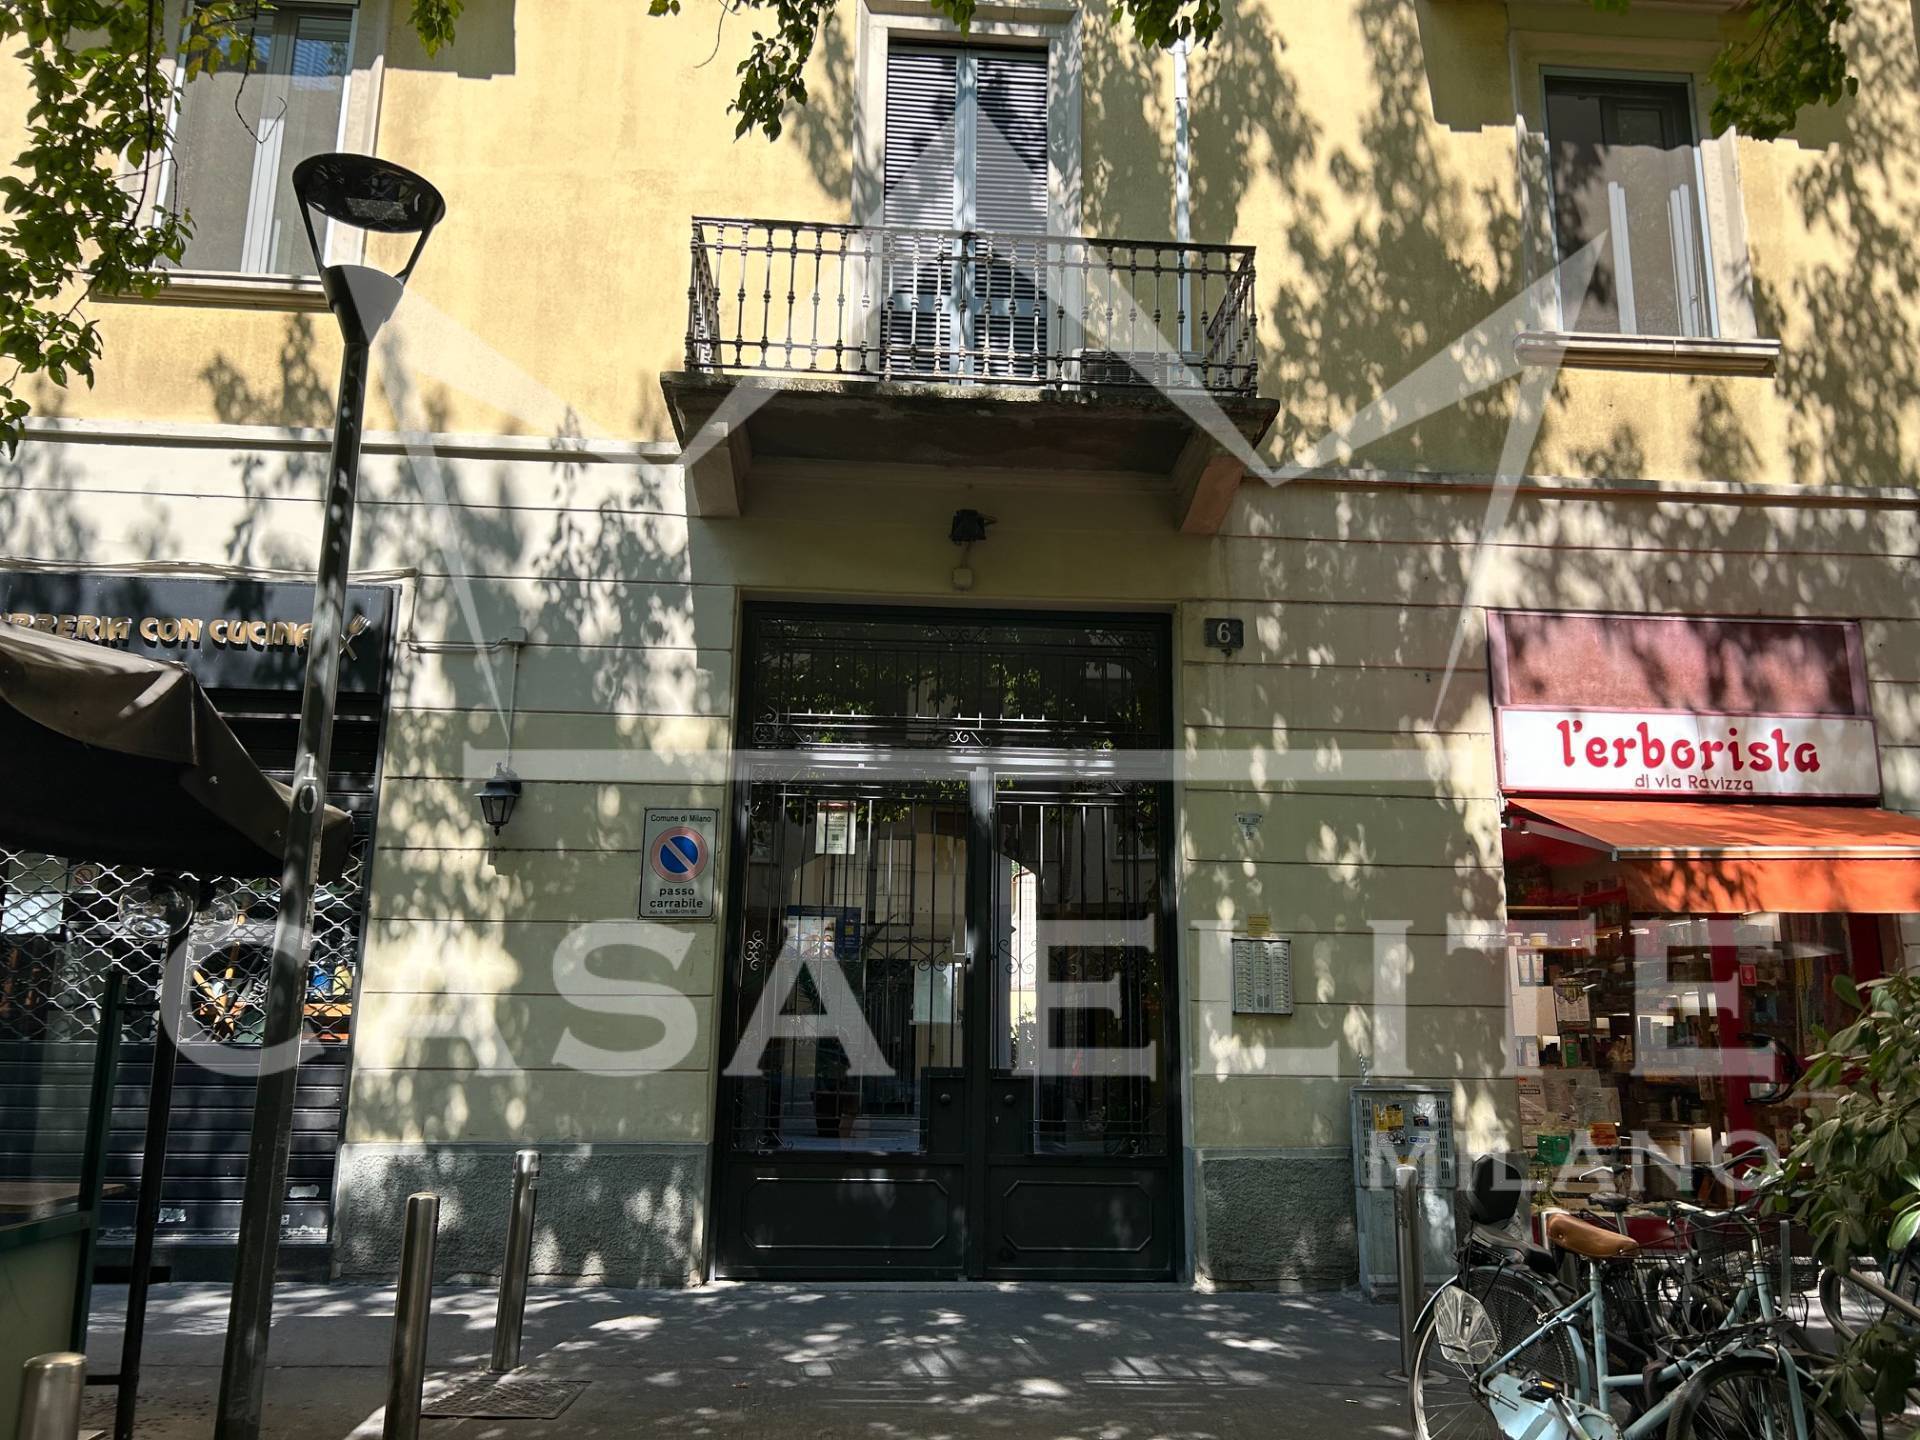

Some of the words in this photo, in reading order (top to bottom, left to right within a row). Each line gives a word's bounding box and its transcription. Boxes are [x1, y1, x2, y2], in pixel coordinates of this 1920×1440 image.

[139, 617, 202, 643] CON
[1216, 622, 1231, 644] 6
[1556, 719, 1821, 773] l'erborista
[1634, 774, 1650, 789] di
[1656, 774, 1682, 789] via
[1688, 774, 1754, 791] Ravizza
[650, 814, 679, 823] Comune
[681, 814, 688, 822] di
[689, 814, 712, 823] Milano
[659, 887, 695, 897] passo
[649, 898, 704, 909] carrabile
